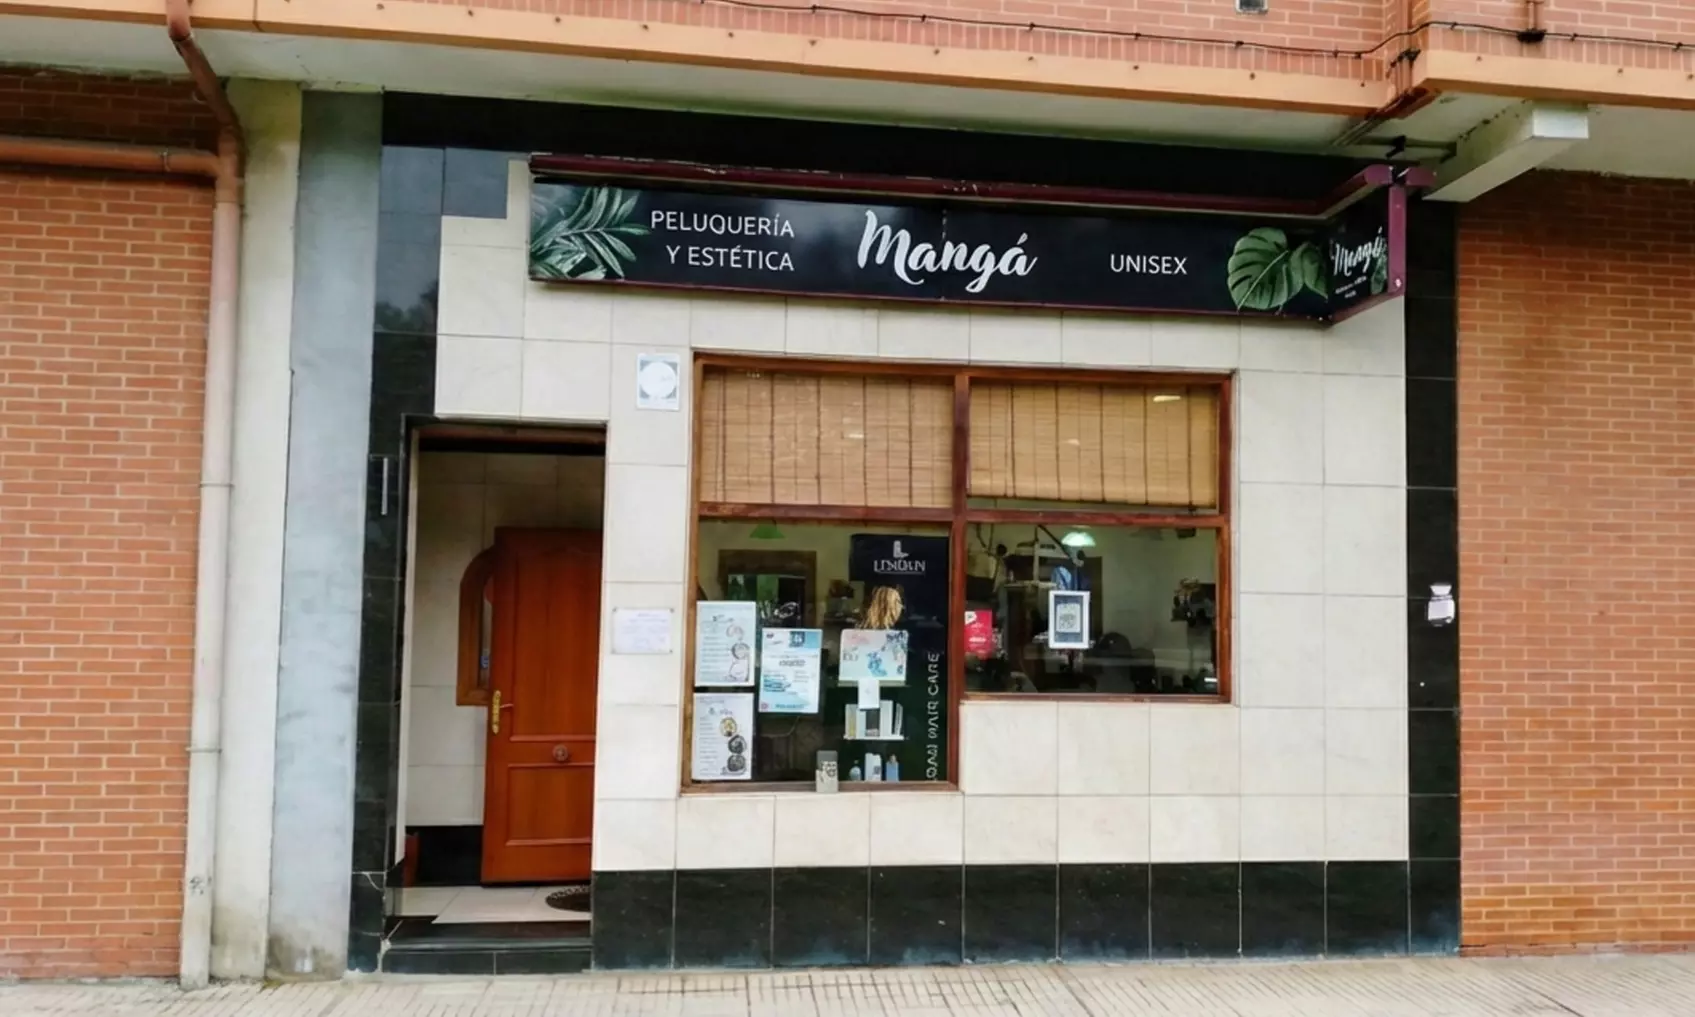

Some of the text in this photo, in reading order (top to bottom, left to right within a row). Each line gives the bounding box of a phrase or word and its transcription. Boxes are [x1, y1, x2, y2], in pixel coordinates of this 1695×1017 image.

[651, 210, 795, 239] PELUQUERÍA
[666, 244, 794, 271] Y ESTÉTICA
[857, 209, 1038, 293] Mangá
[1110, 254, 1187, 275] UNISEX
